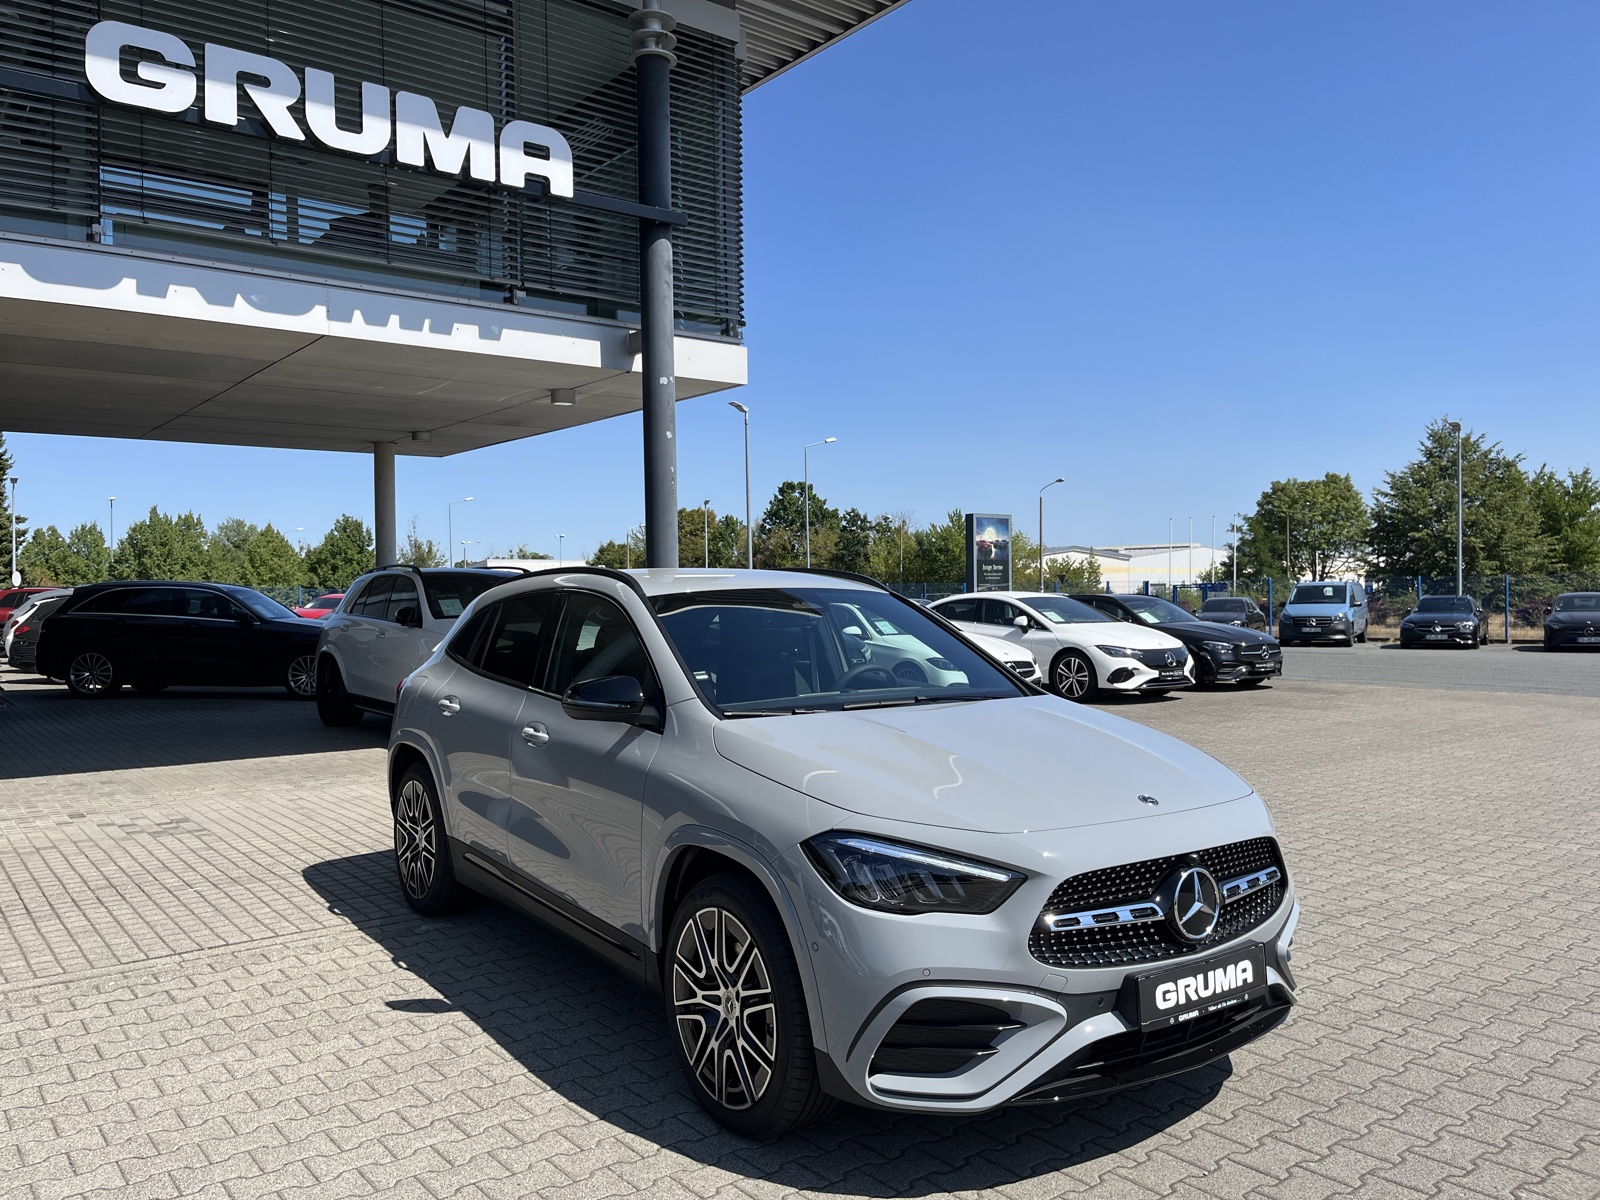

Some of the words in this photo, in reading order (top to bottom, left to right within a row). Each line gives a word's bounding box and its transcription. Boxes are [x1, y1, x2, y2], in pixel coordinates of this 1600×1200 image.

[85, 20, 574, 198] GRUMA
[1155, 960, 1253, 1010] GRUMA
[1178, 1010, 1199, 1022] GRUMA
